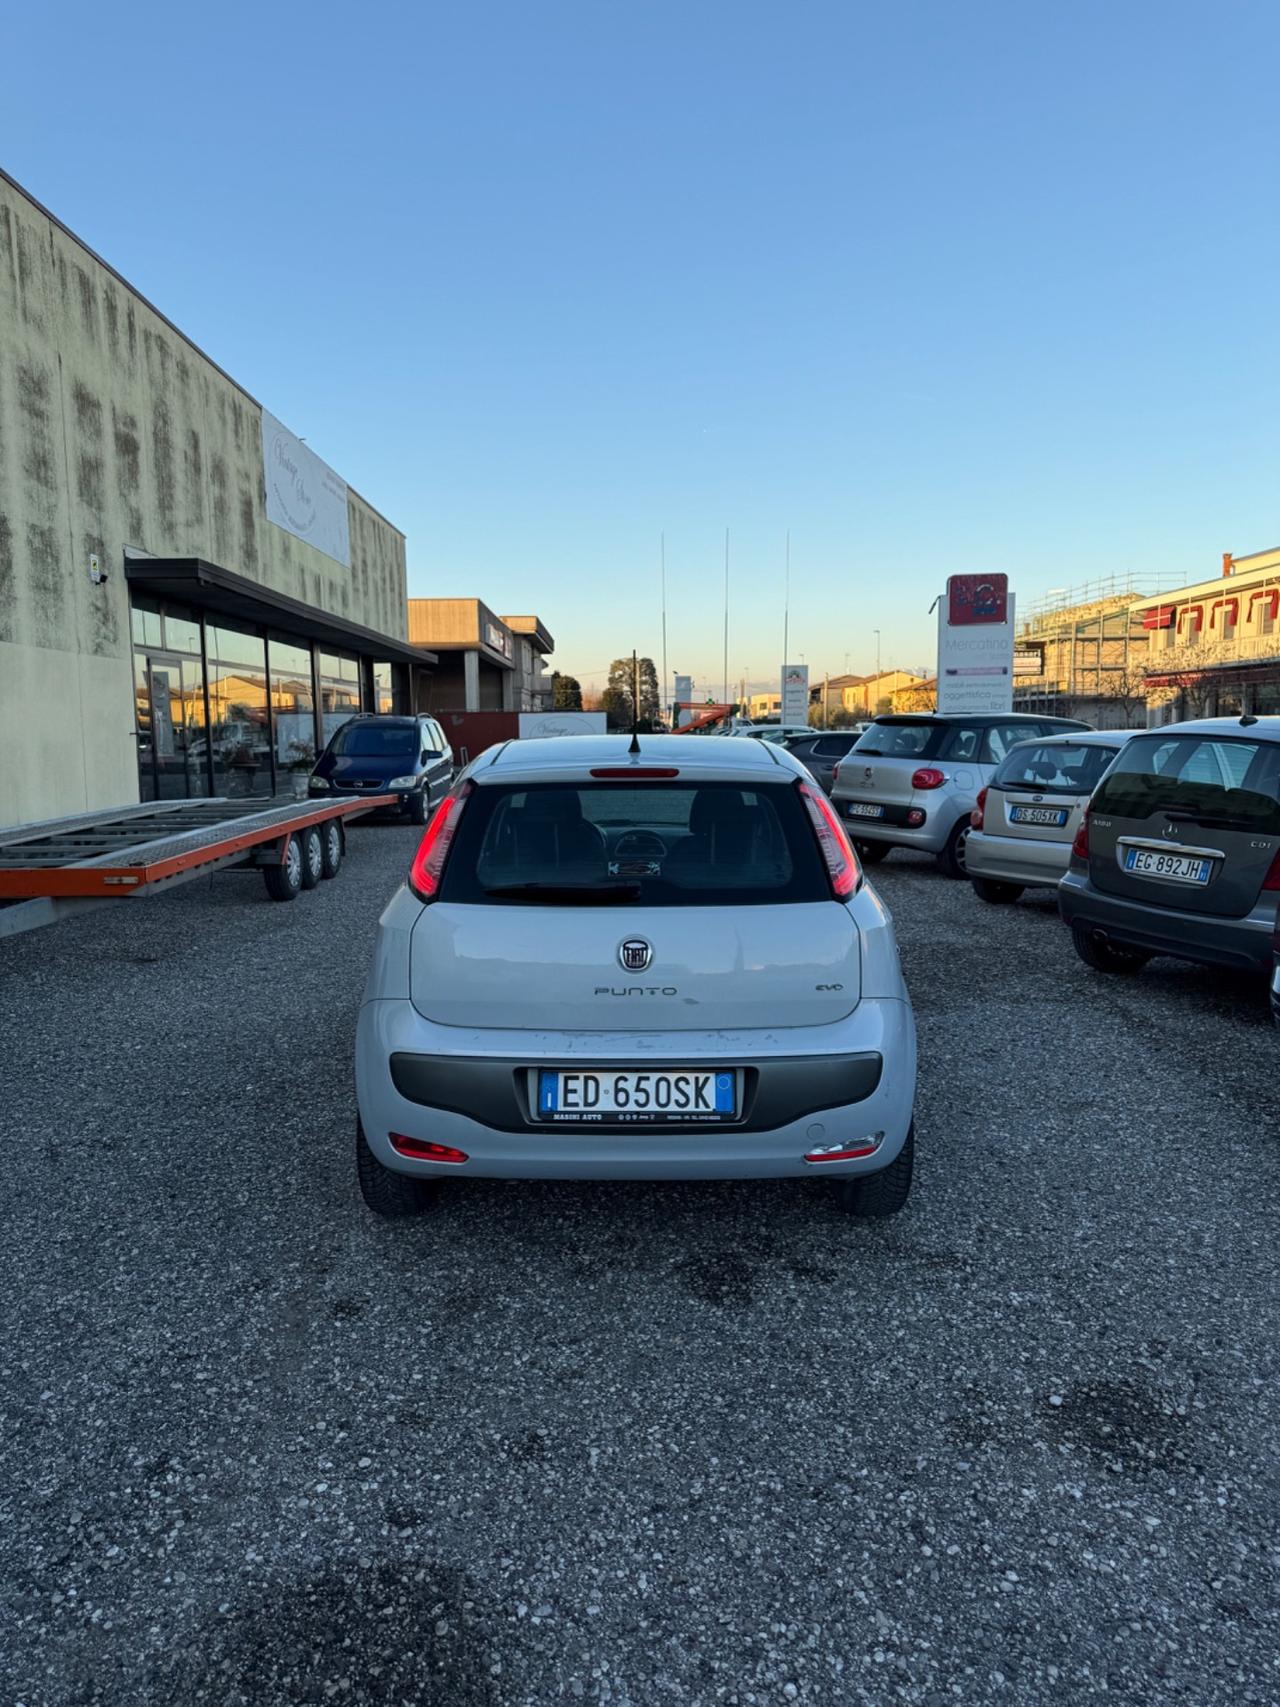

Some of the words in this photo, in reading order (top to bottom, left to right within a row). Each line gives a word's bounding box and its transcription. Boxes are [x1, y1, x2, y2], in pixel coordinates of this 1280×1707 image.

[945, 638, 1008, 650] Mercatino
[1017, 808, 1029, 820] DS
[1251, 841, 1271, 849] CDI
[1136, 853, 1152, 870] EG
[1156, 856, 1201, 878] 892JH
[594, 987, 677, 996] PUNTO
[563, 1075, 599, 1108] ED
[614, 1075, 711, 1109] 650SK
